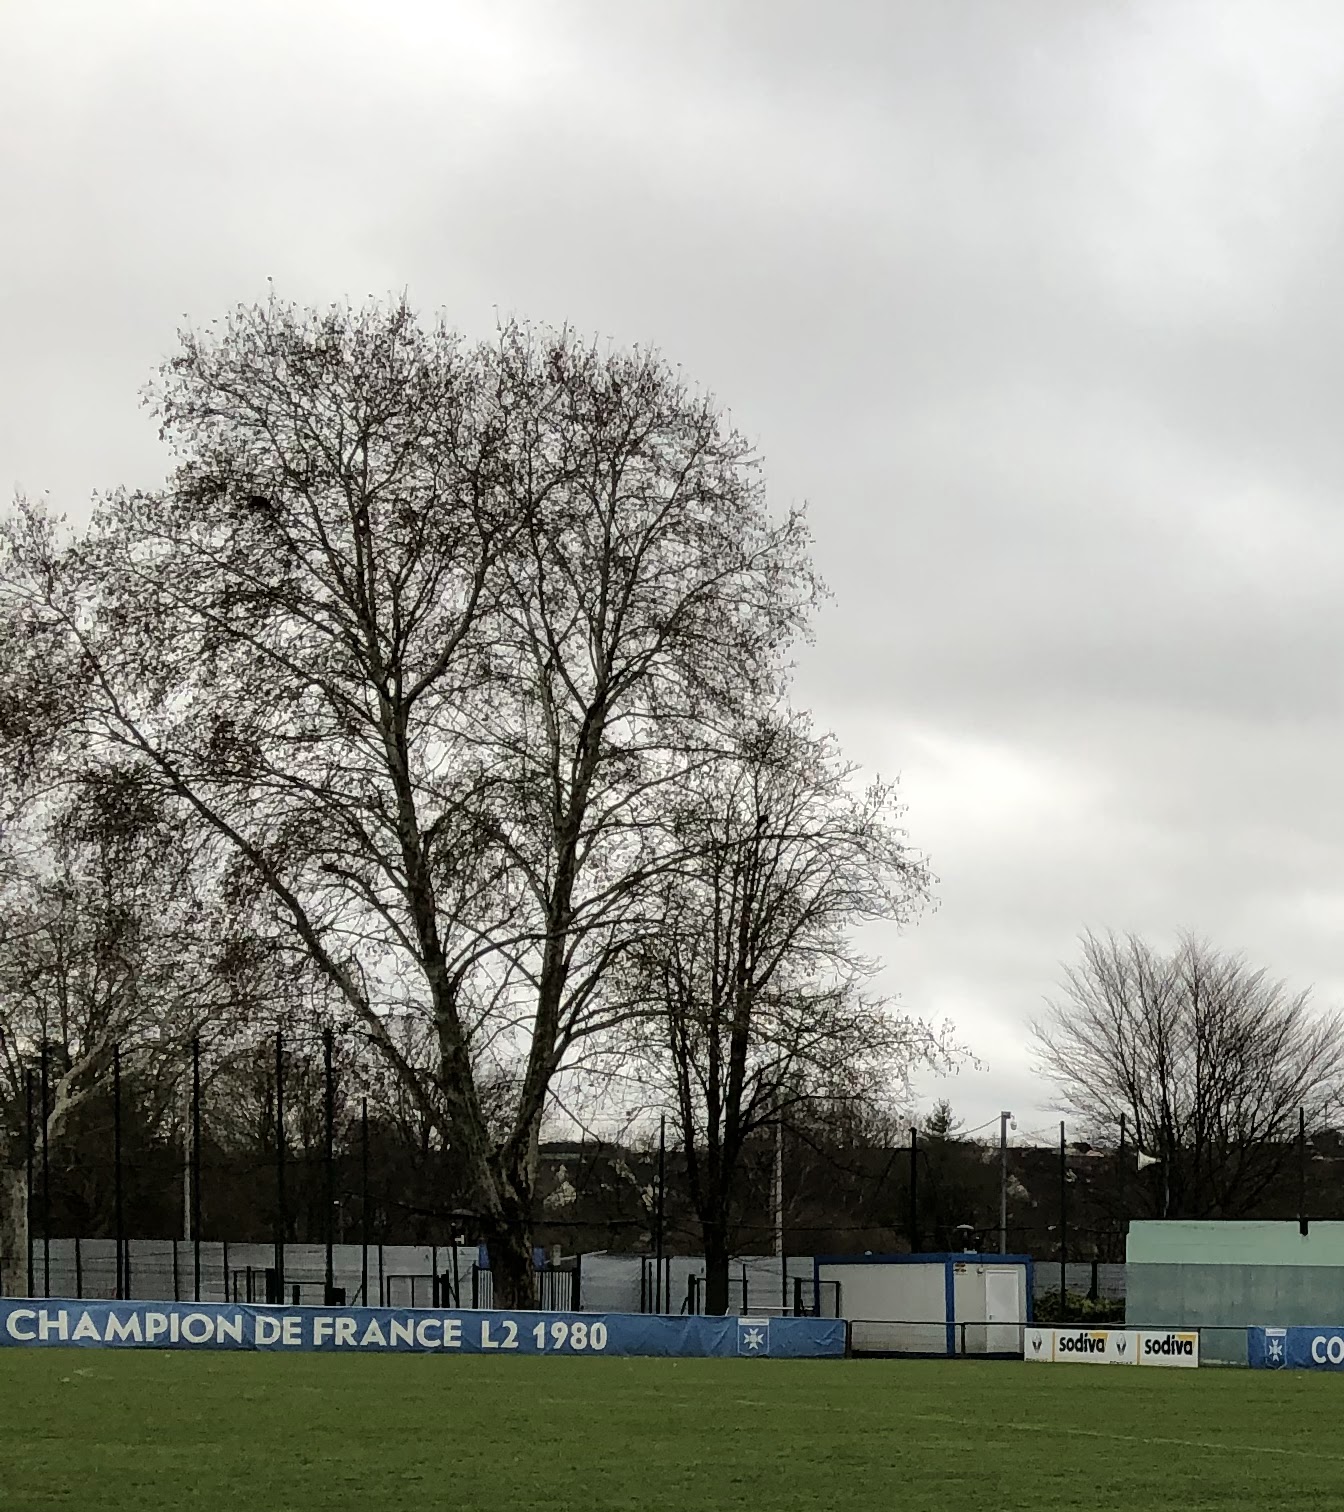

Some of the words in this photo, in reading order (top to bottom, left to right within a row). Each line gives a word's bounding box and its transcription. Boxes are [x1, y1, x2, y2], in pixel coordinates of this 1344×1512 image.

[6, 1308, 243, 1344] CHAMPION
[254, 1314, 302, 1345] DE
[313, 1316, 462, 1348] FRANCE
[481, 1320, 519, 1348] L2
[532, 1321, 608, 1350] 1980
[1058, 1332, 1106, 1353] sodiva
[1144, 1334, 1193, 1356] sodiva
